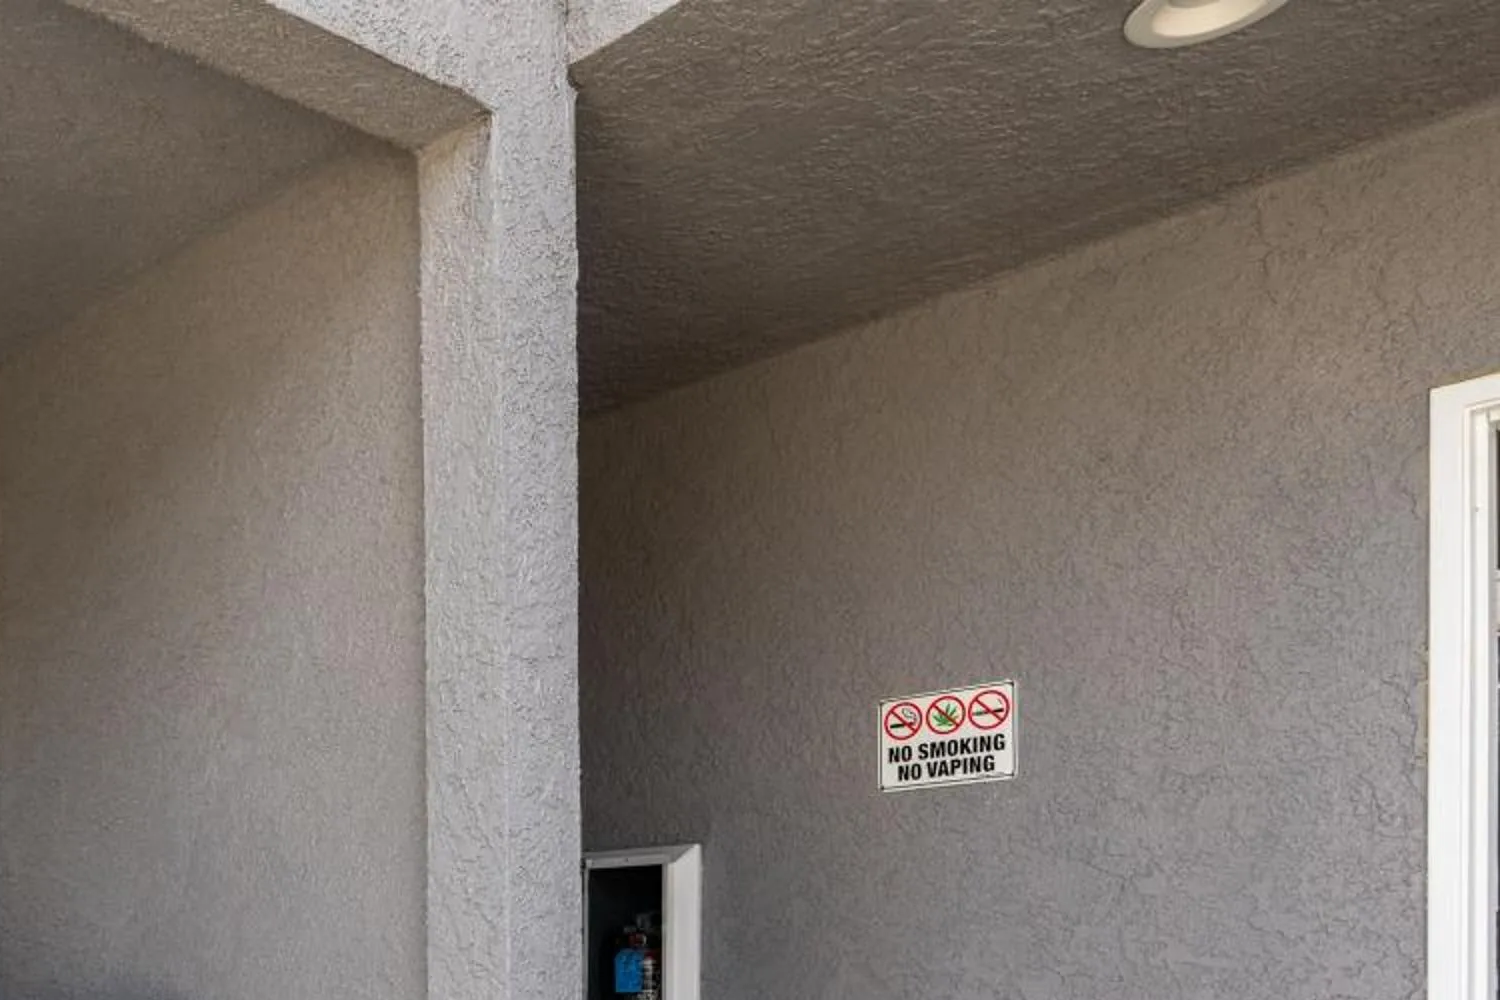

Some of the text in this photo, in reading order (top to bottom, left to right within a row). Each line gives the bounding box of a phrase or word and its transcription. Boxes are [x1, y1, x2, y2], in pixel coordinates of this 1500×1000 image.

[888, 733, 1006, 764] NO SMOKING
[898, 755, 996, 781] NO VAPING
